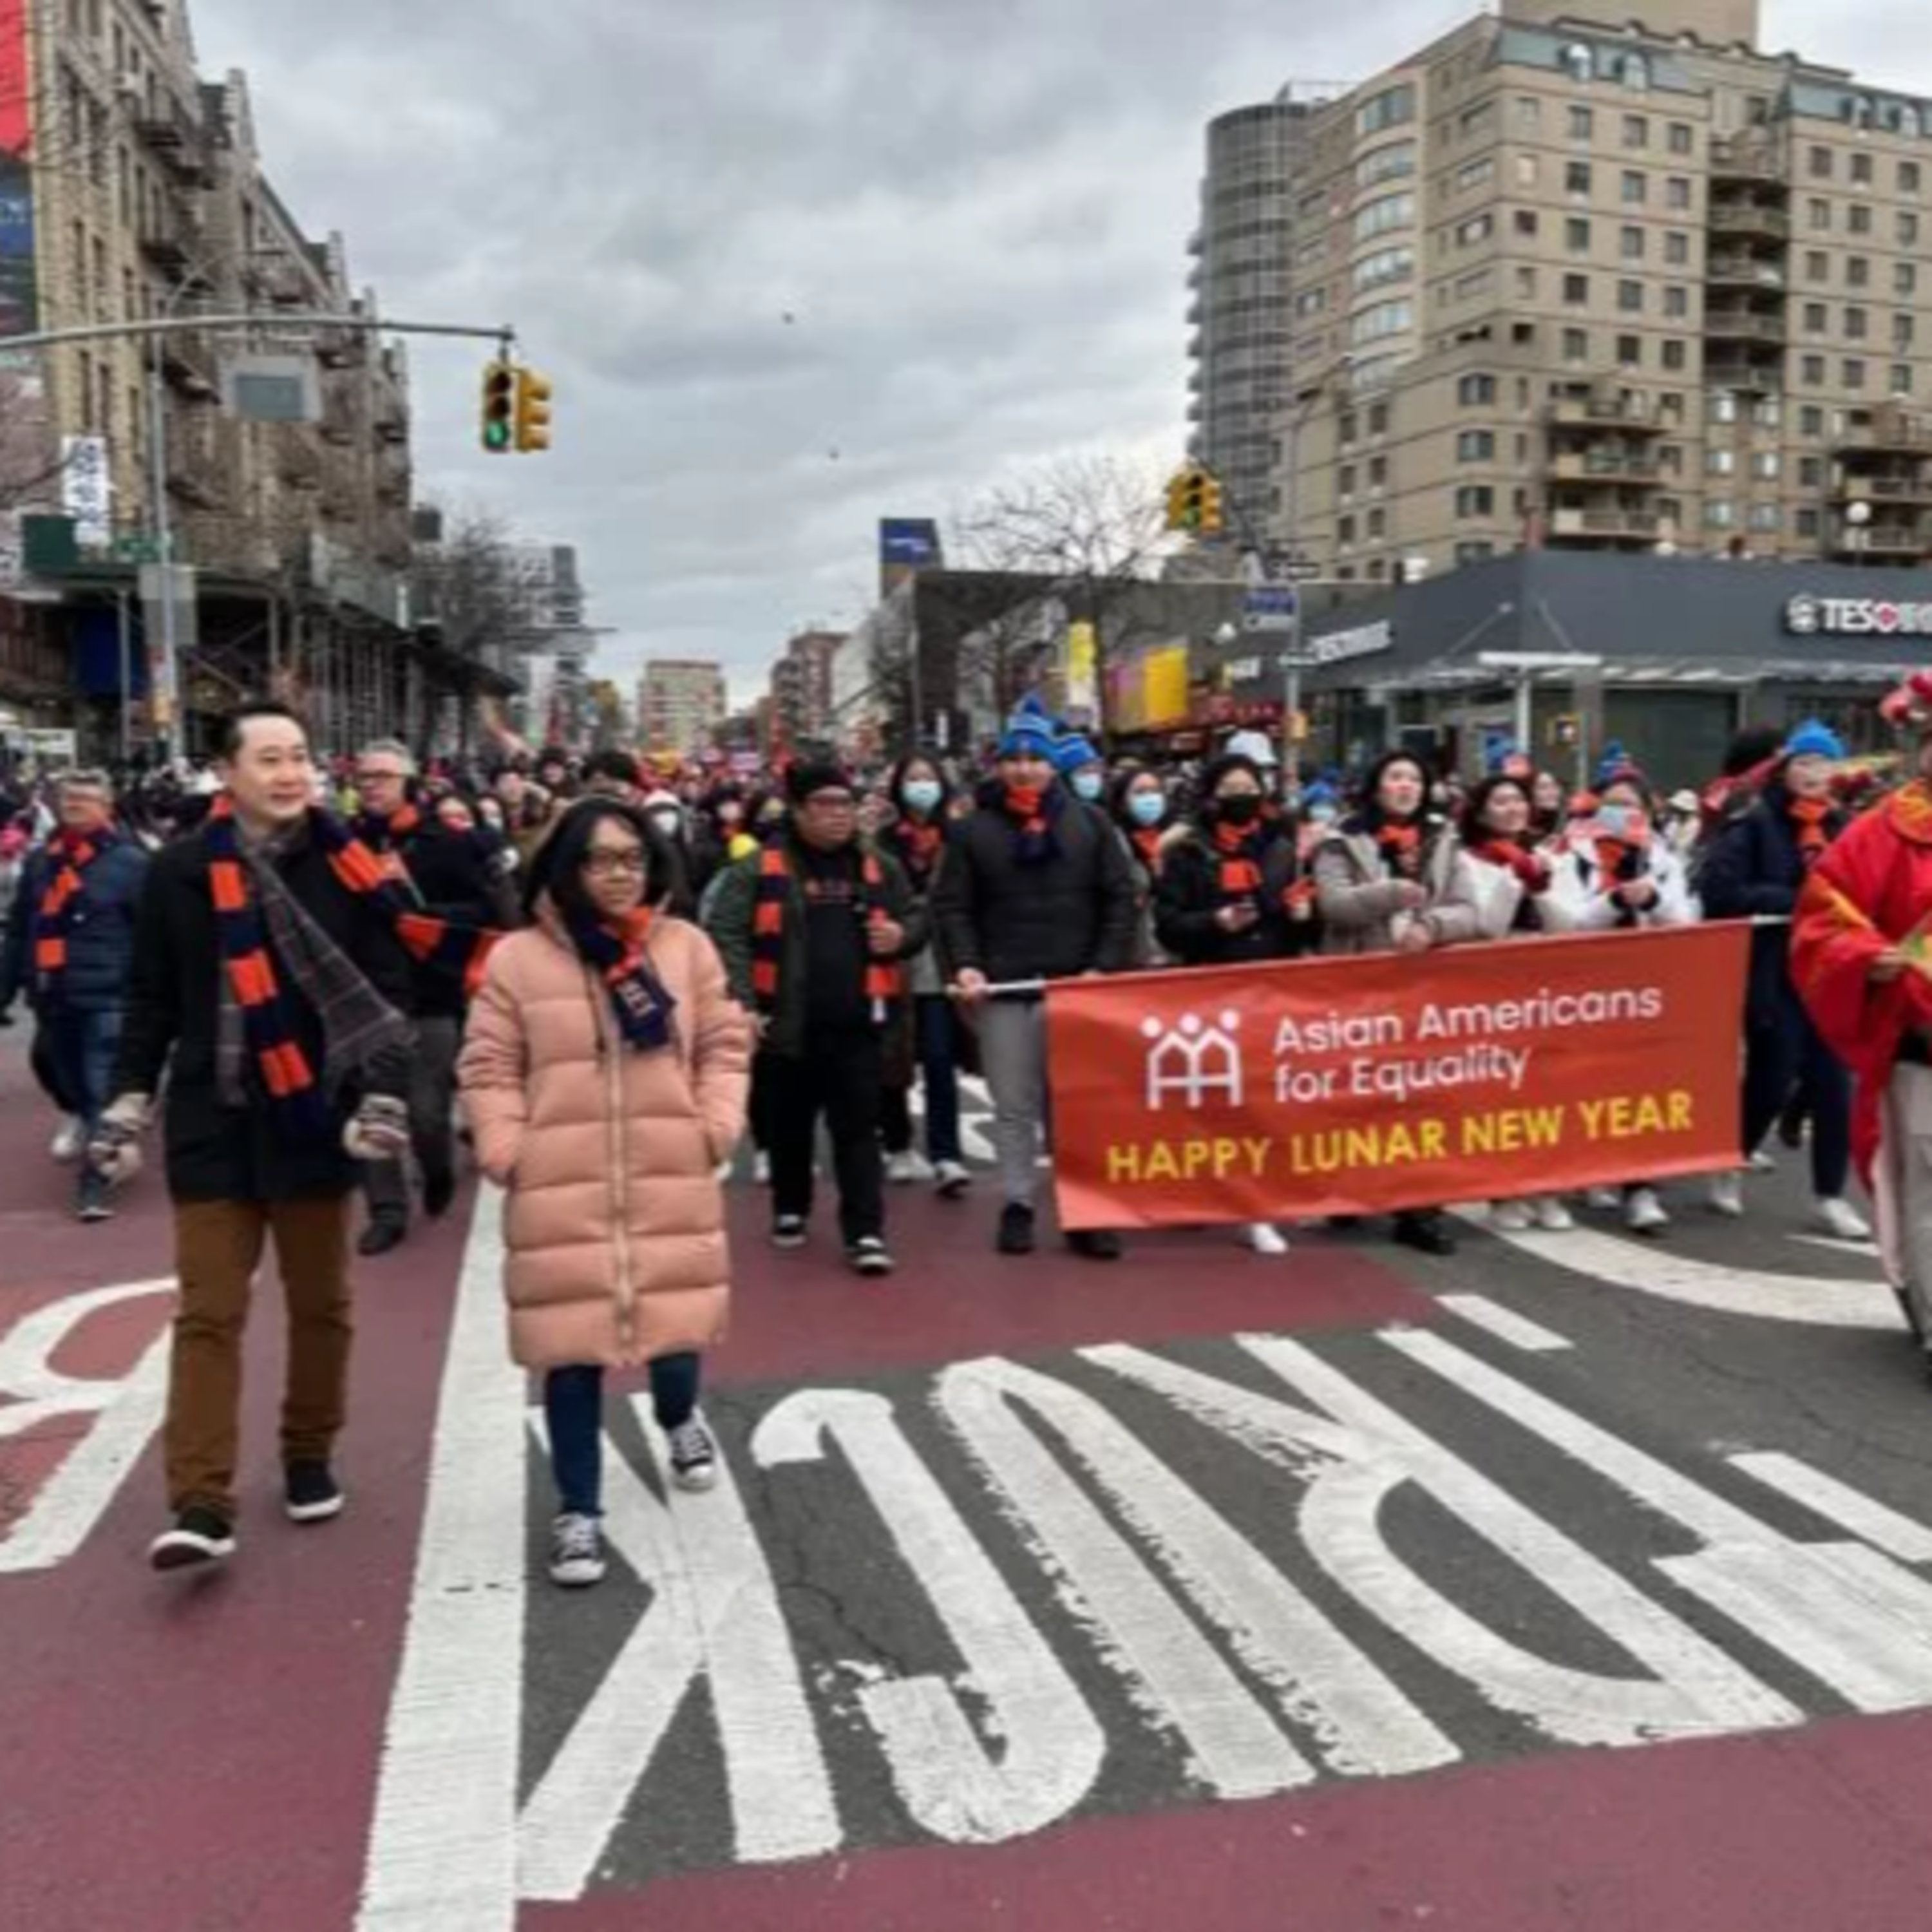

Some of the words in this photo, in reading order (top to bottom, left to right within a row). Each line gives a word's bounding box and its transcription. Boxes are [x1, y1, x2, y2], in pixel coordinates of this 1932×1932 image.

[1274, 1010, 1403, 1054] Asian
[1417, 987, 1662, 1039] Americans
[1275, 1063, 1338, 1102] for
[1351, 1042, 1531, 1102] Equality
[1107, 1137, 1271, 1182] HAPPY
[1291, 1119, 1448, 1173] LUNAR
[1461, 1106, 1565, 1155] NEW
[1578, 1090, 1694, 1140] YEAR
